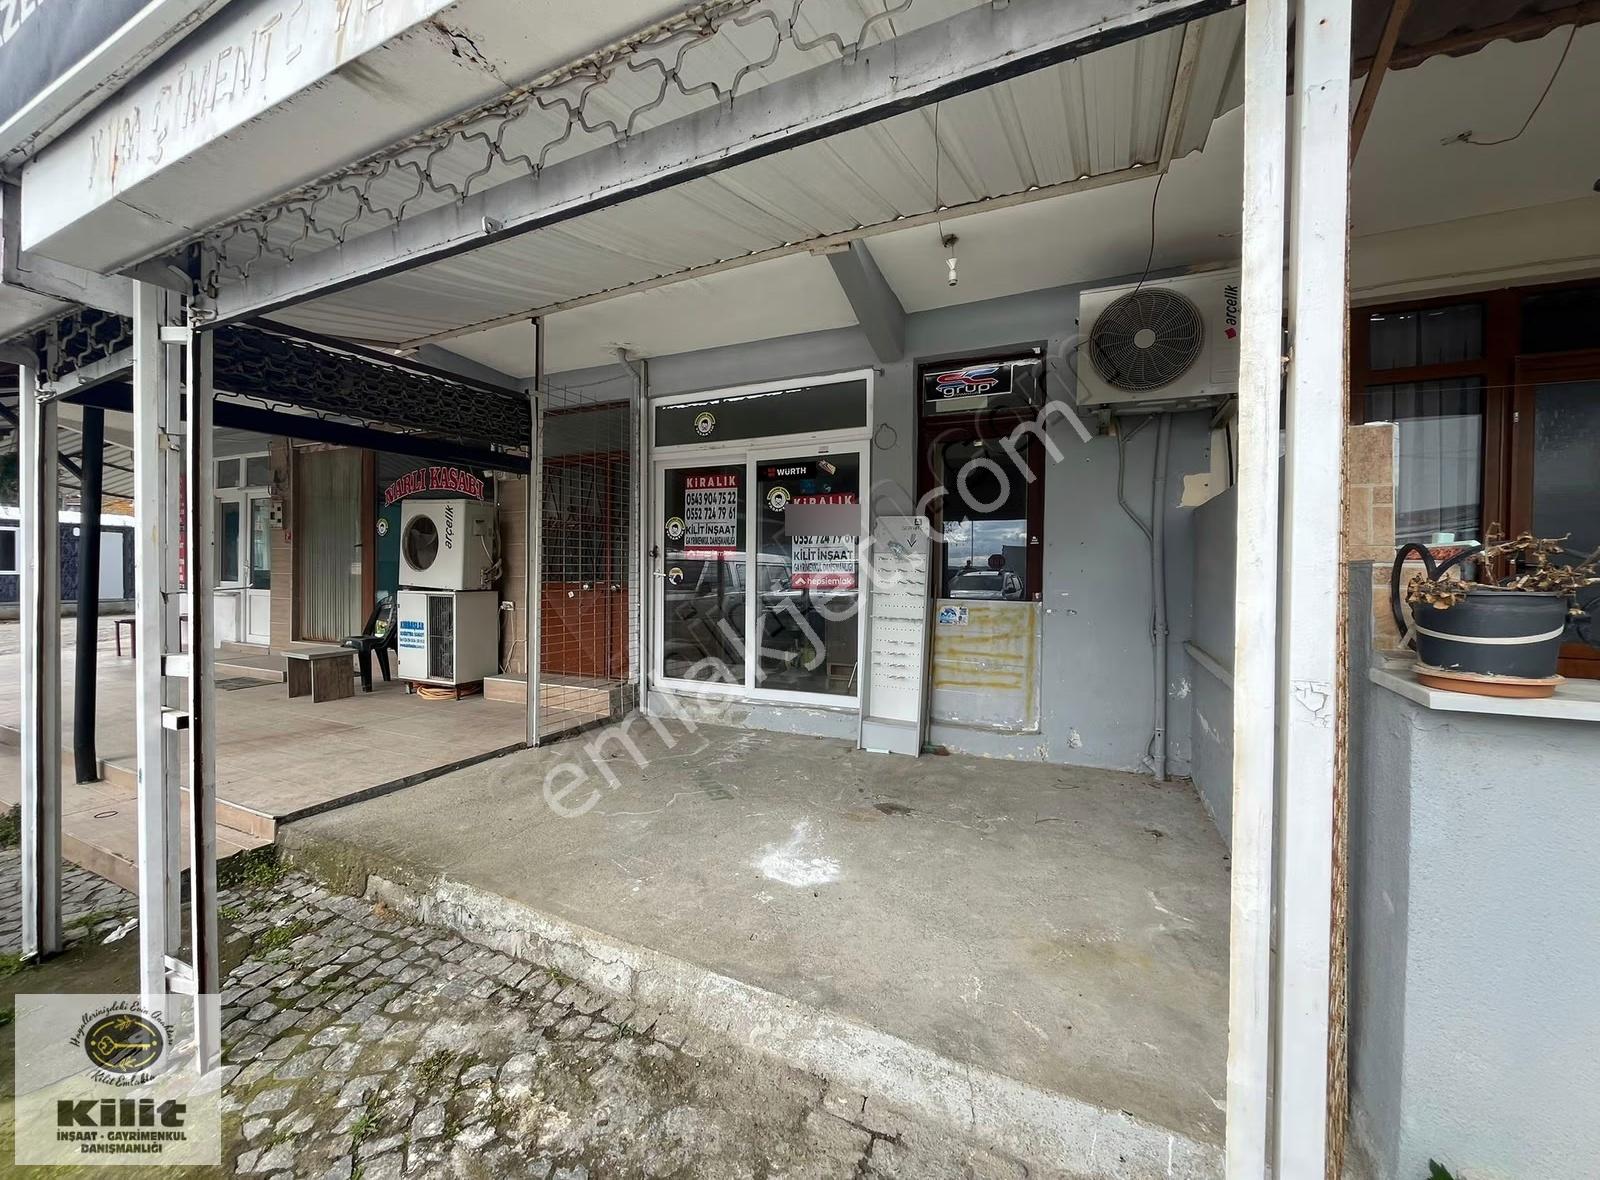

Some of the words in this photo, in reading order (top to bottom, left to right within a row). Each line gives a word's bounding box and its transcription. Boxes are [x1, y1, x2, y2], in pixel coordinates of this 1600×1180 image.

[1224, 285, 1240, 326] arçelik
[943, 384, 990, 398] grup
[777, 467, 807, 476] WÜRTH
[384, 468, 427, 507] NARLI
[428, 466, 485, 500] KASABI
[686, 492, 703, 506] 0543
[727, 491, 736, 505] 22
[686, 507, 703, 520] 0552
[704, 507, 716, 520] 724
[718, 507, 727, 520] 79
[728, 506, 736, 520] 61
[444, 505, 454, 550] arçelik
[706, 523, 736, 536] İNŞAAT
